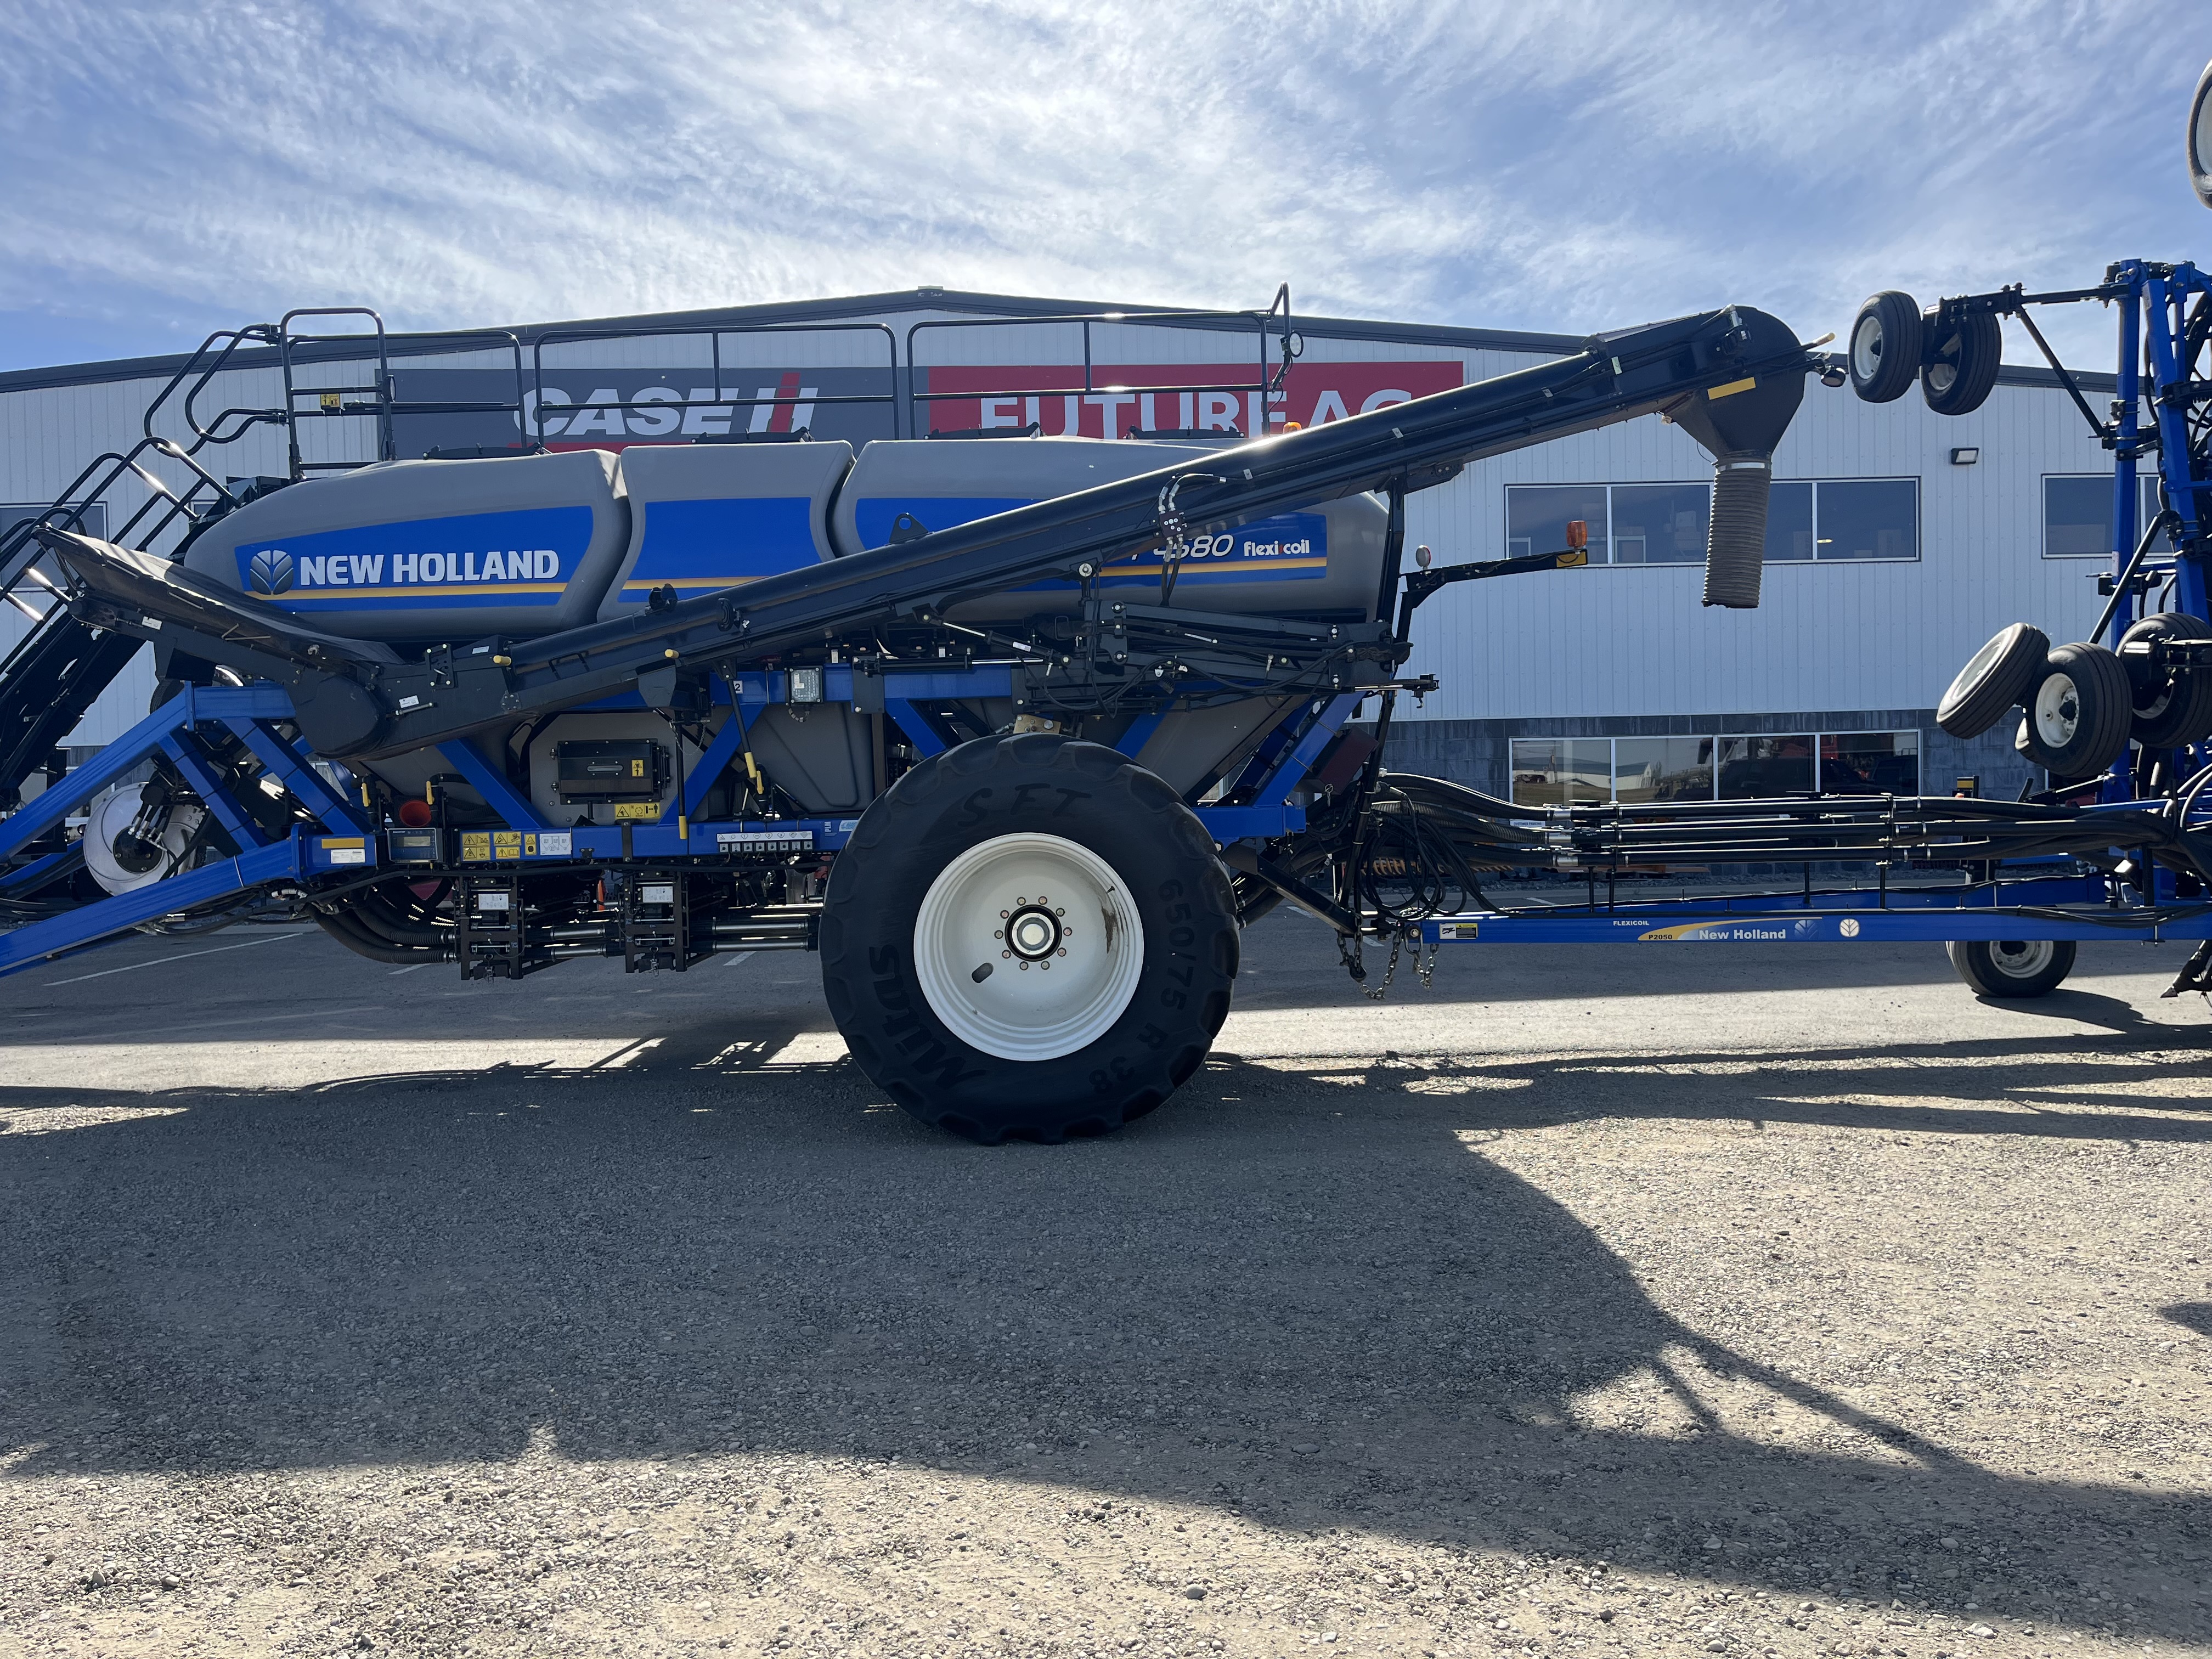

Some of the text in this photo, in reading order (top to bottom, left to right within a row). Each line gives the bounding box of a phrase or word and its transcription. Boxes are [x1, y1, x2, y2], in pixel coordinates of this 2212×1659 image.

[514, 373, 819, 436] CASE IH
[980, 391, 1287, 440] FUTURE
[300, 550, 560, 585] NEW HOLLAND
[957, 783, 1092, 827] SFT
[1699, 929, 1786, 940] New Holland
[1088, 878, 1197, 1094] 650/75 R 38
